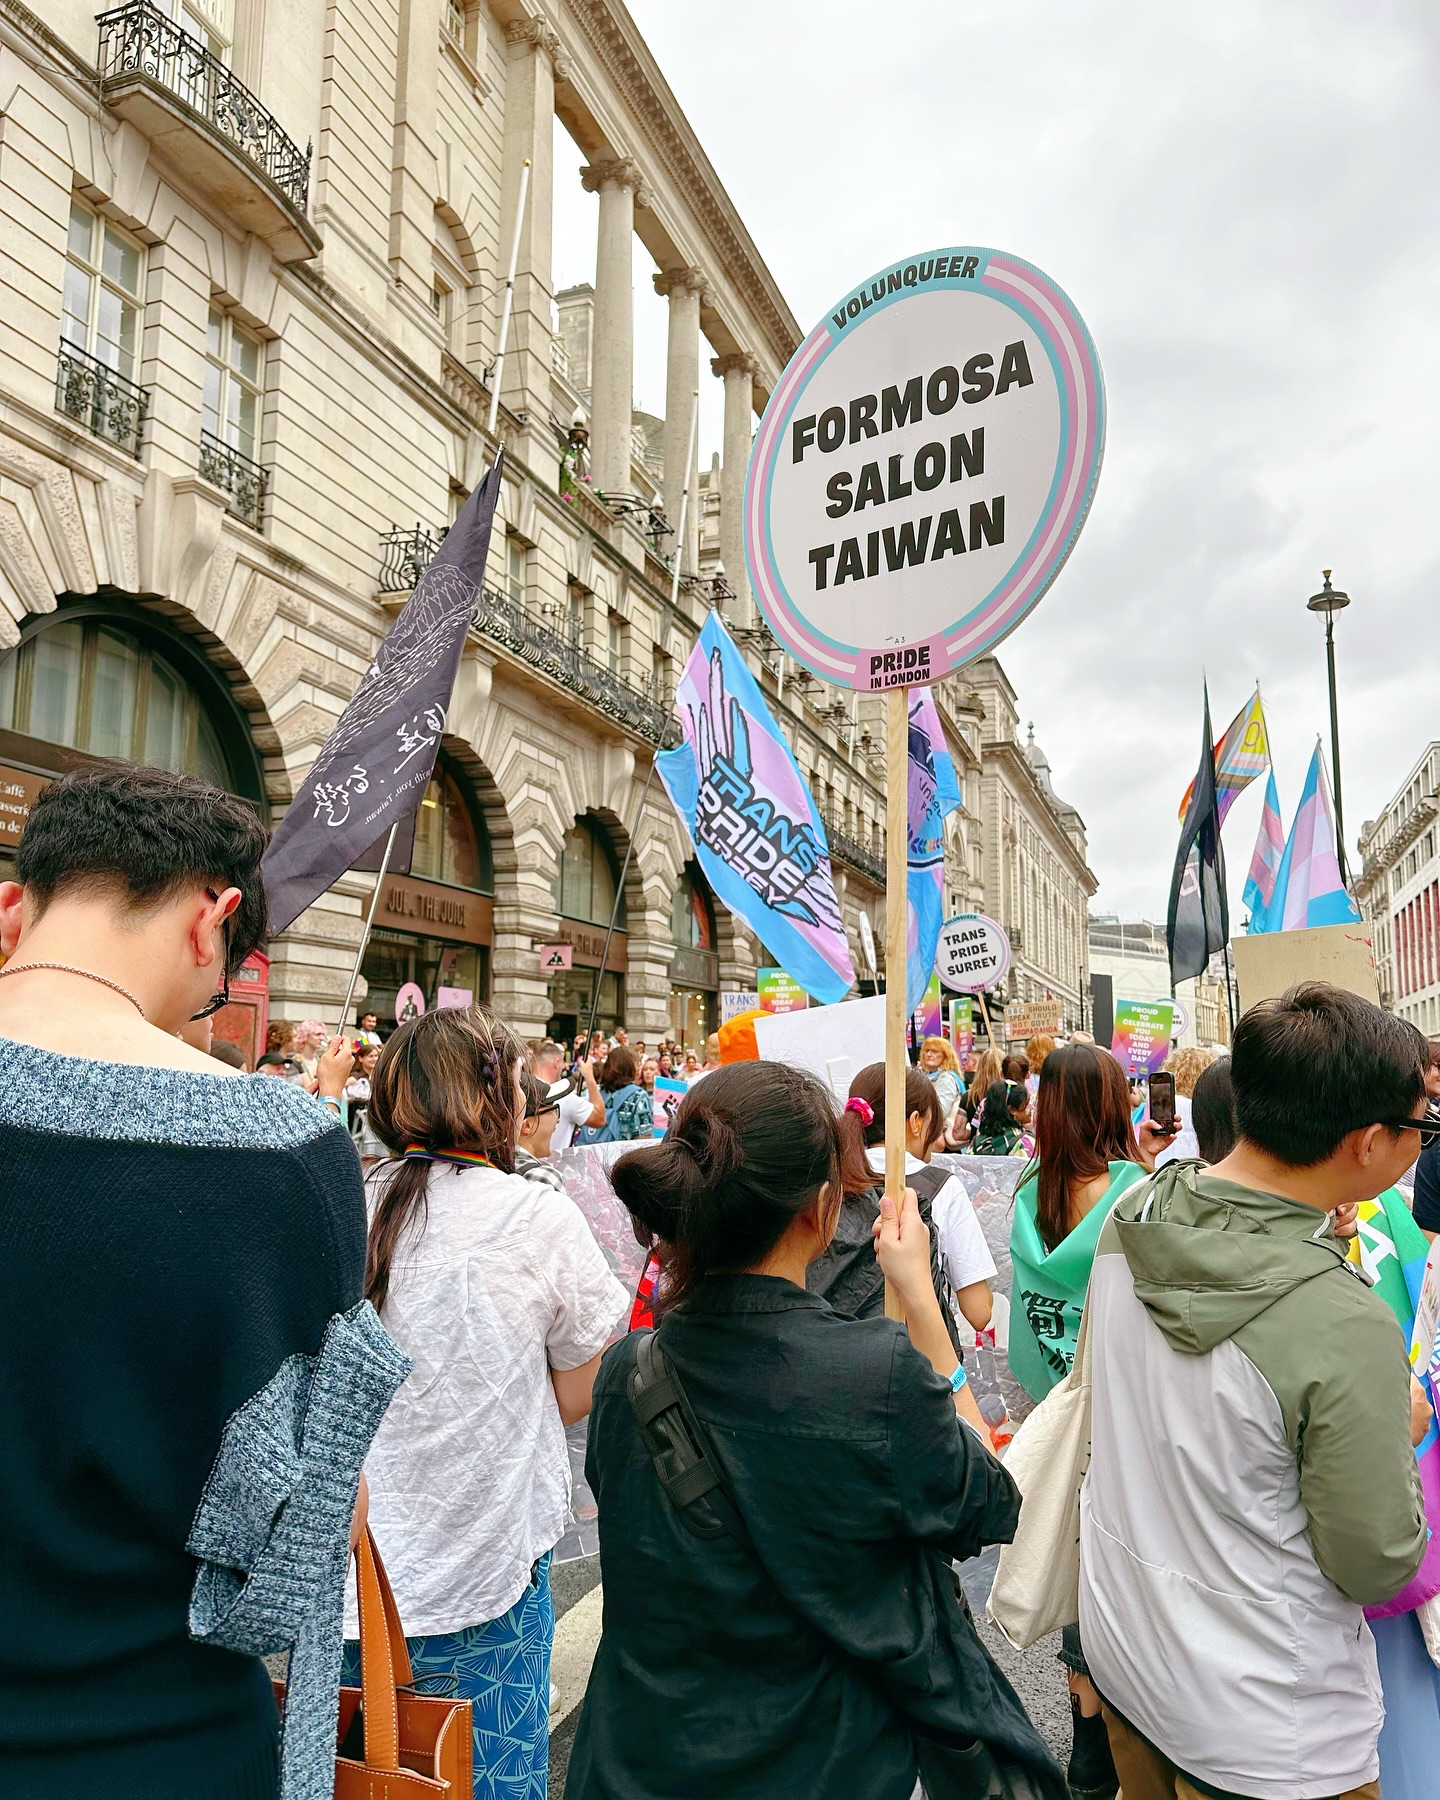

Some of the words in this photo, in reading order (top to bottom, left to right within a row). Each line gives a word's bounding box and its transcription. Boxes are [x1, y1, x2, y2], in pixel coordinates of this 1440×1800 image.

[832, 256, 979, 330] VOLUNQUEER
[793, 340, 1034, 464] FORMOSA
[826, 427, 985, 519] SALON
[808, 495, 1005, 591] TAIWAN
[870, 677, 882, 689] IN
[885, 668, 930, 687] LONDON
[711, 757, 818, 875] TRANS
[7, 820, 20, 833] de
[698, 781, 806, 896] PRIDE
[417, 893, 440, 921] THE
[944, 928, 987, 946] TRANS
[949, 943, 988, 960] PRIDE
[947, 956, 997, 976] SURREY
[764, 985, 800, 993] CELEBRATE
[723, 994, 756, 1006] TRANS
[1007, 1007, 1024, 1015] BBC
[1028, 1004, 1057, 1013] SHOULD
[1009, 1013, 1030, 1021] SPEAK
[1033, 1011, 1057, 1019] TRUTH
[1131, 1006, 1158, 1015] PROUD
[1012, 1026, 1057, 1036] PROPAGANDA
[1122, 1018, 1164, 1030] CELEBRATE
[1128, 1034, 1154, 1042] TODAY
[1128, 1047, 1152, 1057] EVERY
[1131, 1054, 1147, 1062] DAY
